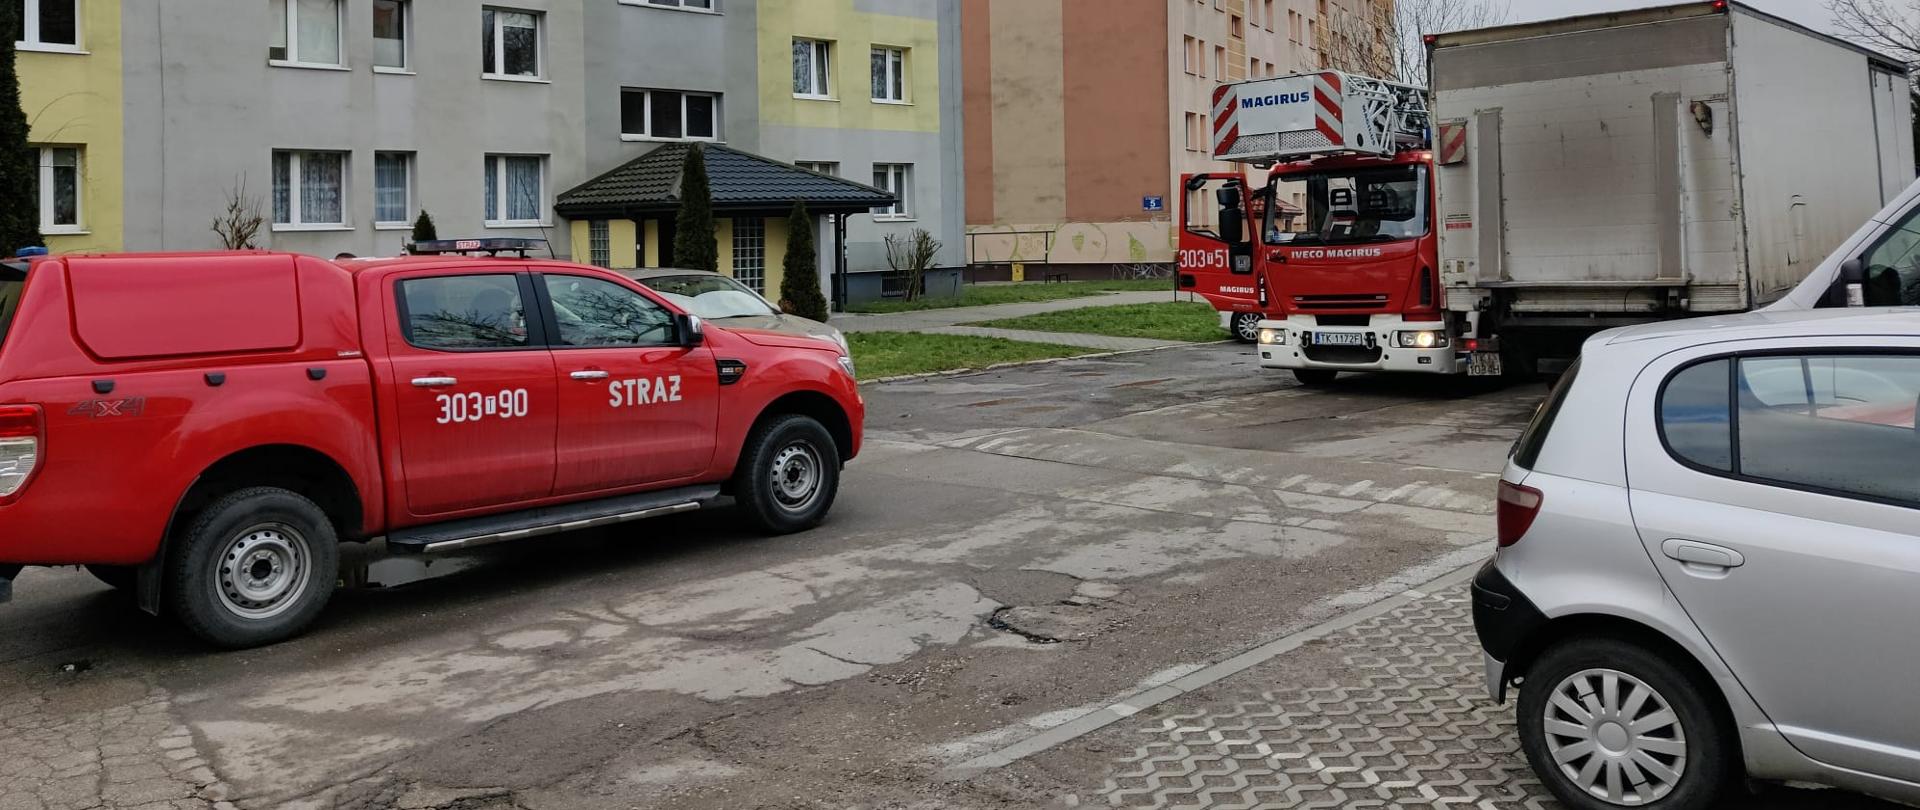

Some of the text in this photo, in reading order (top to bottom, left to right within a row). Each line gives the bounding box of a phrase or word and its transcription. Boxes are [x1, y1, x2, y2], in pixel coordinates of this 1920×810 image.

[1241, 91, 1310, 109] MAGIRUS
[1291, 248, 1381, 259] IVECO MAGIRUS
[1220, 286, 1254, 294] MAGIRUS
